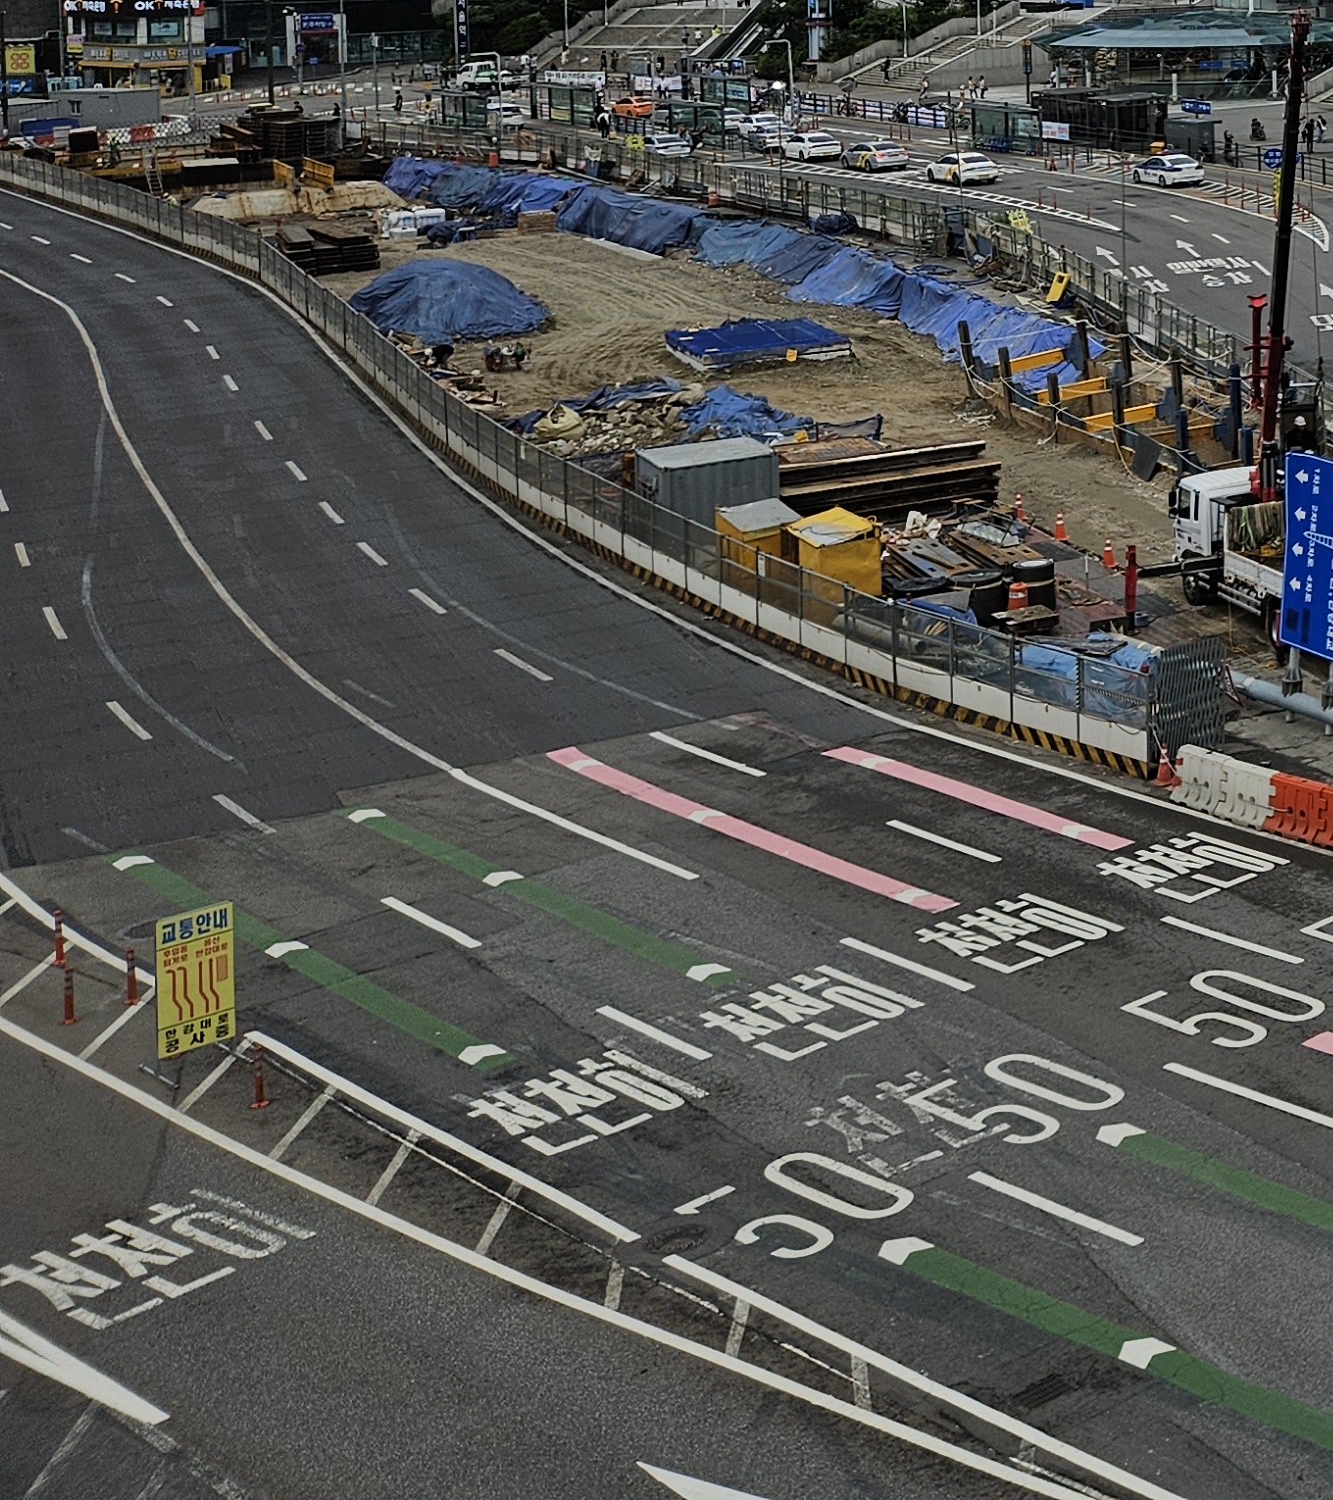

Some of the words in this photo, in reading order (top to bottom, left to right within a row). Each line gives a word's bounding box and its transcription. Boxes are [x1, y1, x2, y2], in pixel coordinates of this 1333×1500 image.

[64, 0, 78, 12] OK
[134, 1, 155, 11] OK
[1096, 830, 1291, 904] 천천히
[162, 907, 228, 945] 교통안내
[204, 935, 220, 948] 용산
[915, 891, 1125, 975] 천천히
[165, 1012, 229, 1041] 한강대로
[165, 1023, 229, 1054] 공사중
[699, 962, 925, 1062] 천천히
[1120, 967, 1326, 1050] 50
[468, 1048, 711, 1157] 천천히
[902, 1052, 1126, 1145] 50
[0, 1188, 317, 1330] 천천히
